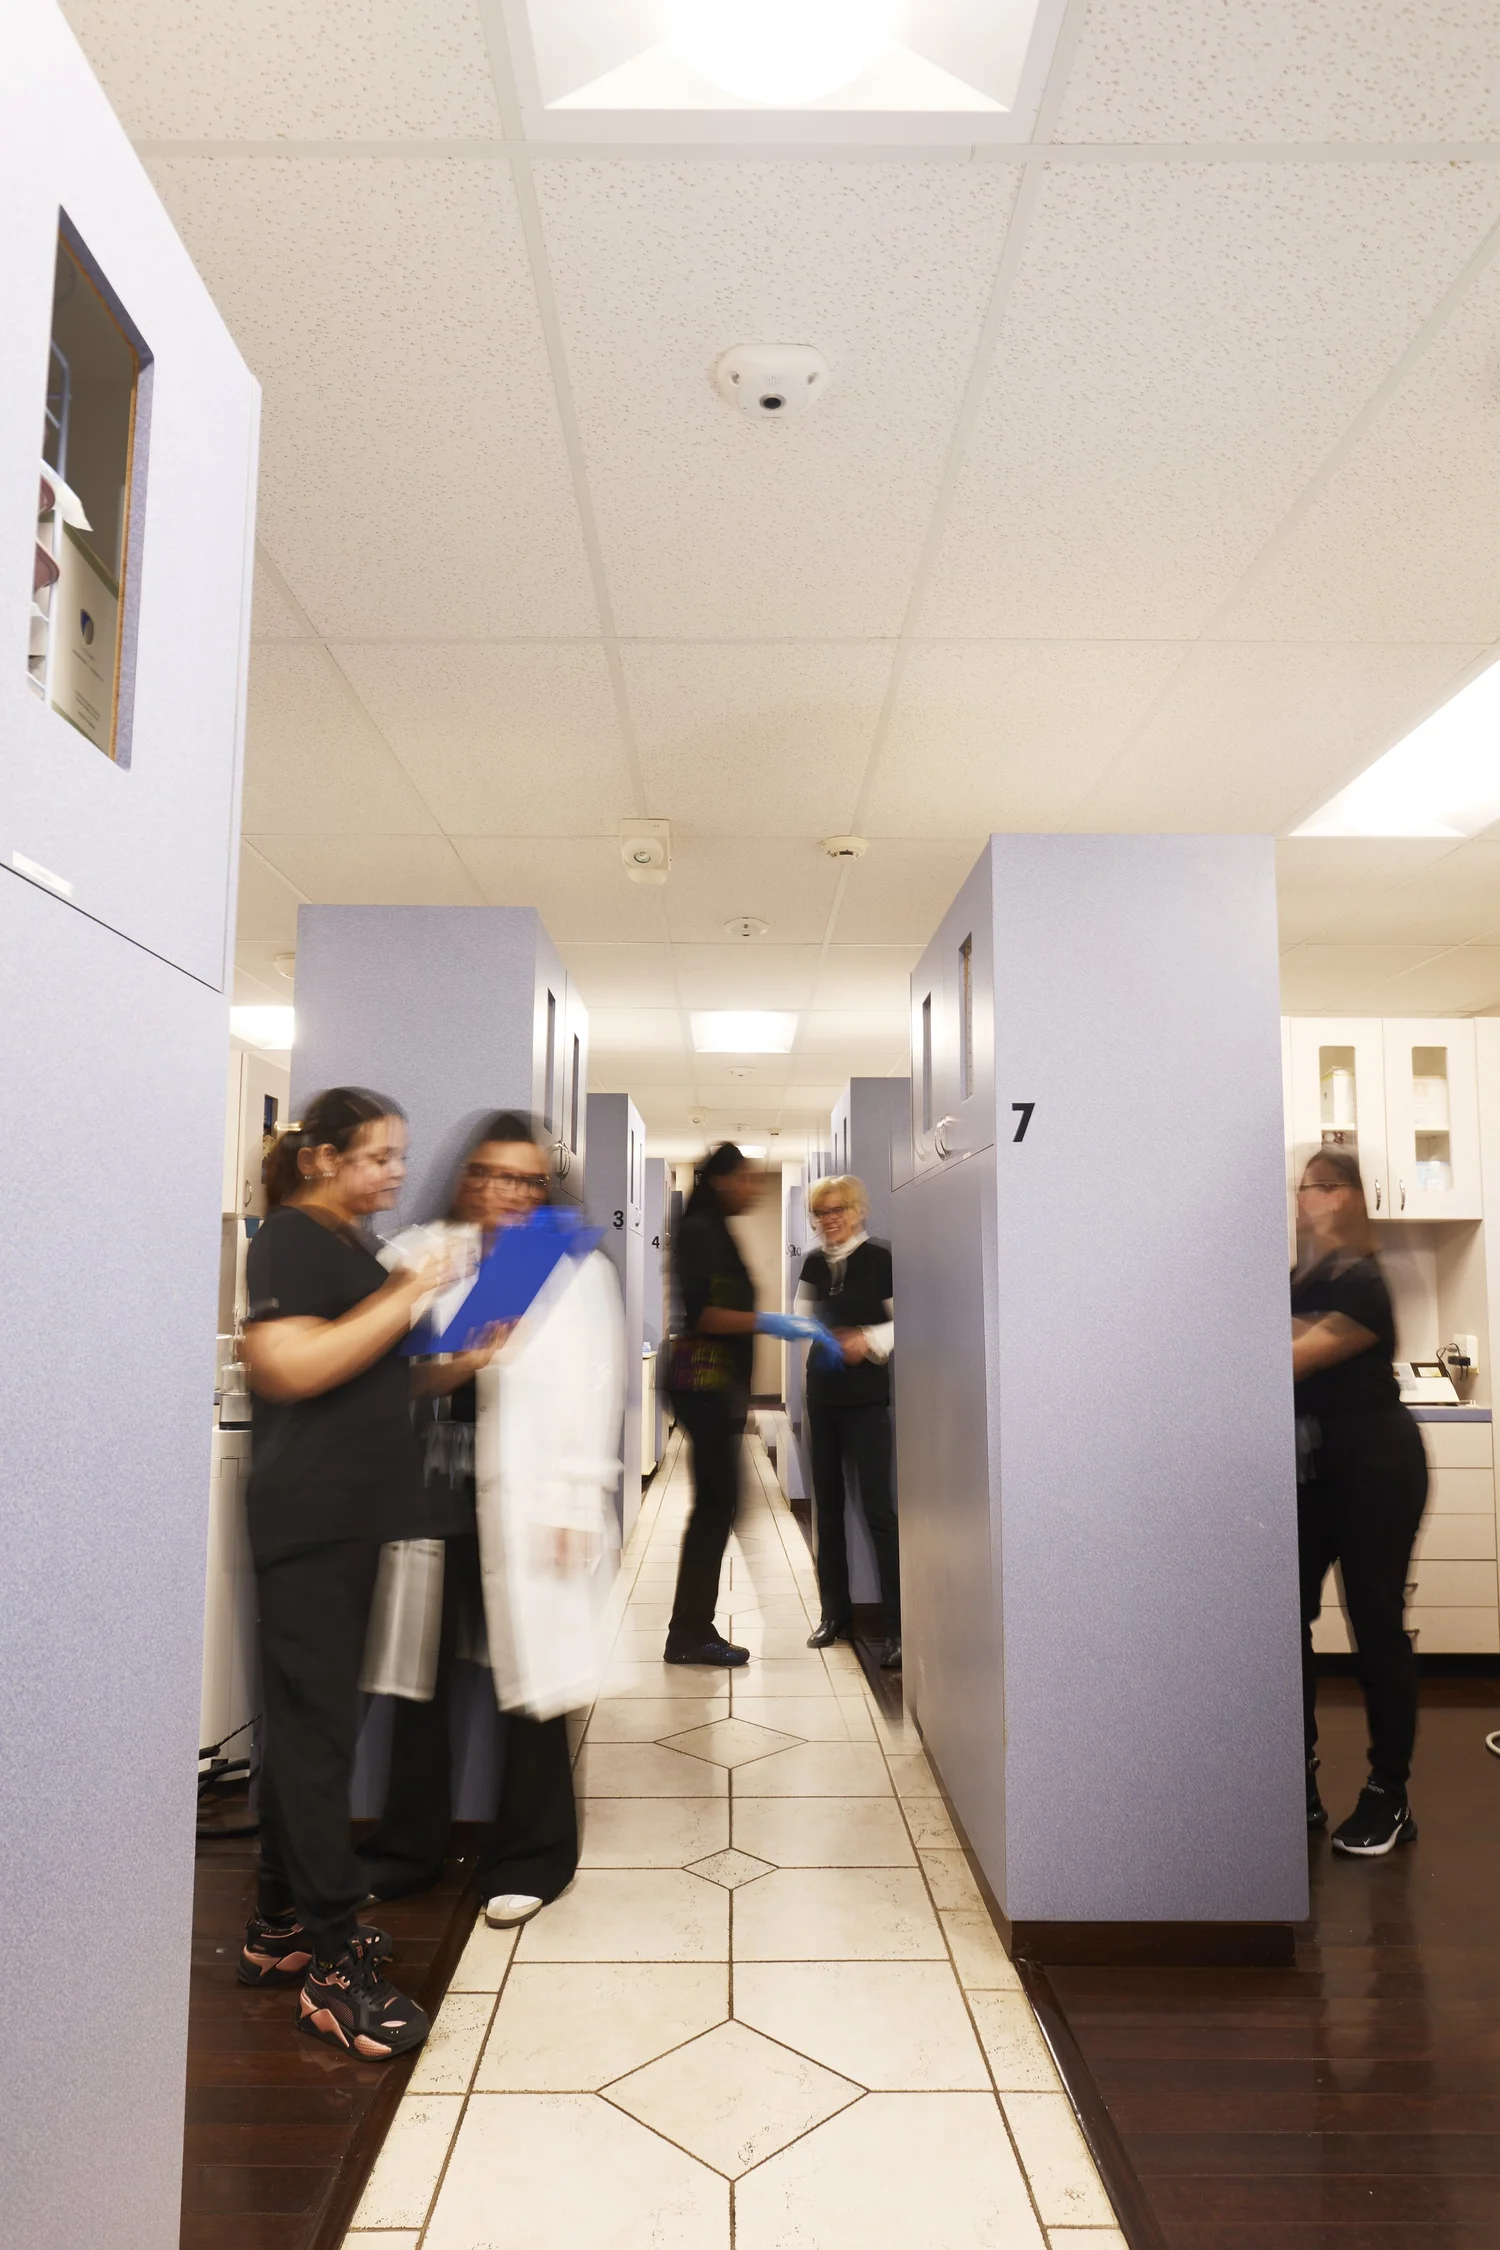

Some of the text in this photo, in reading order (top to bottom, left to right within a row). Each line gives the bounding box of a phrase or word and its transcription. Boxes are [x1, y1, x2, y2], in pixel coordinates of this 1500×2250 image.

[1011, 1102, 1036, 1142] 7
[613, 1210, 624, 1228] 3
[651, 1235, 660, 1249] 4
